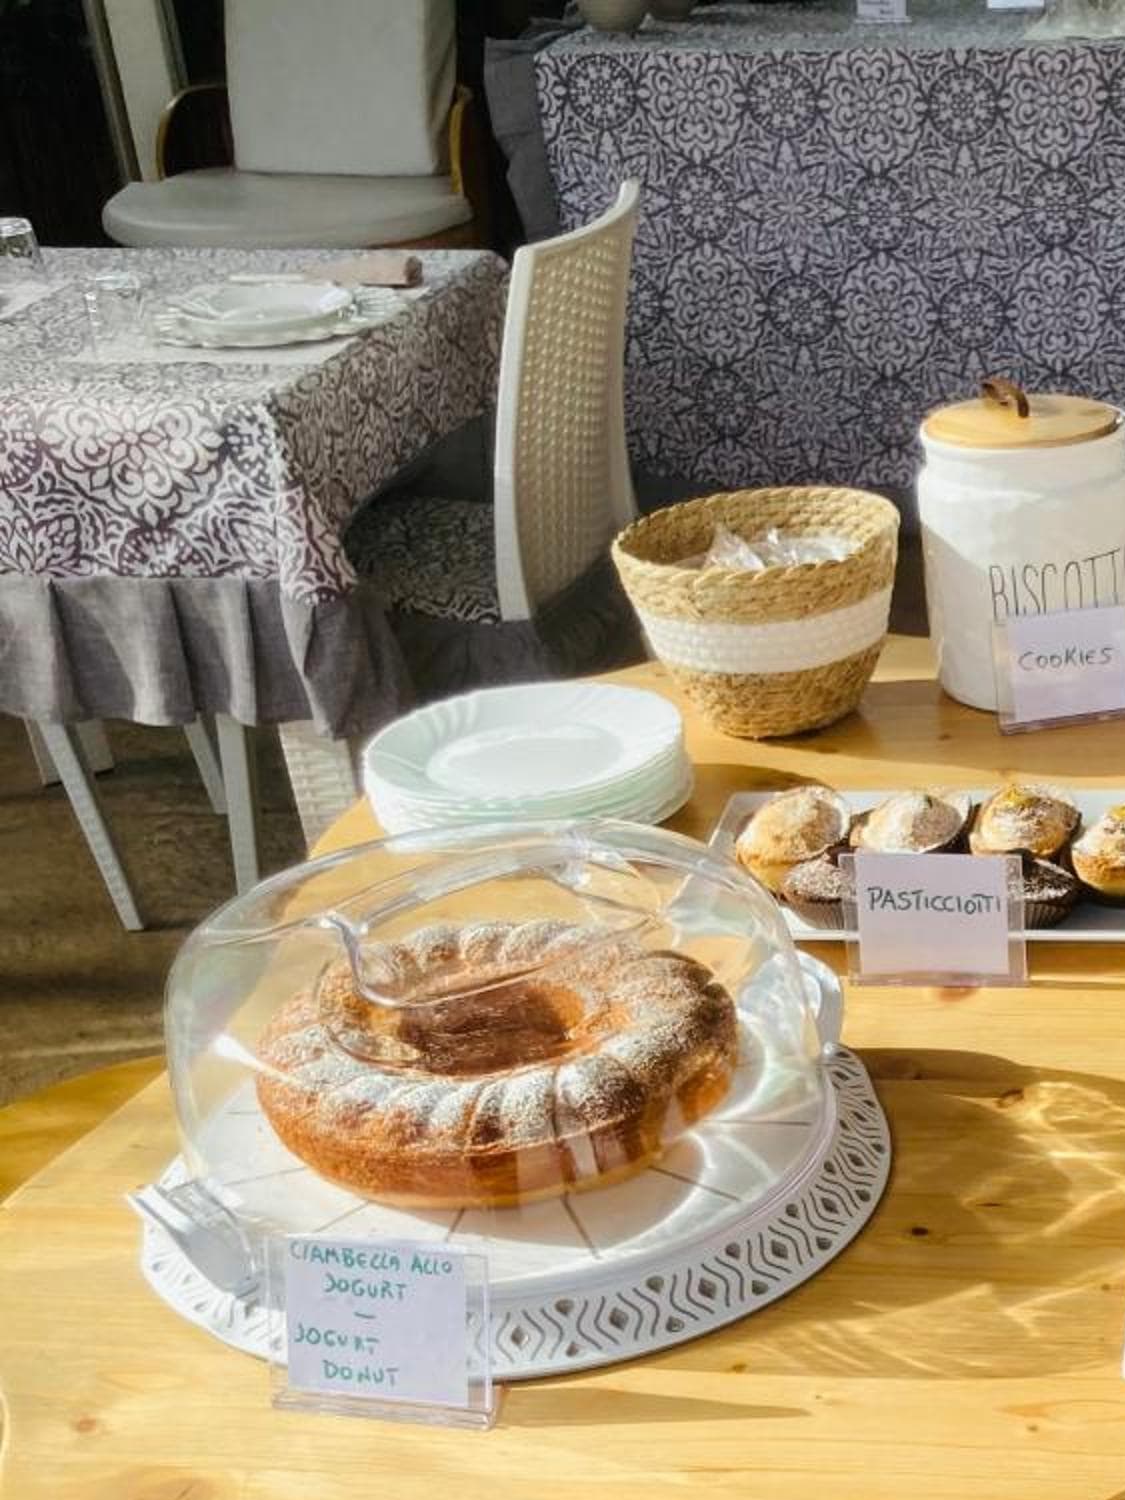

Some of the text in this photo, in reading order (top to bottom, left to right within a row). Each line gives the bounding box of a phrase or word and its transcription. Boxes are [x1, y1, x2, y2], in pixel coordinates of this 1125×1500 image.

[1018, 645, 1114, 672] COOKIES
[867, 886, 1001, 915] PASTICCIOTTI
[290, 1240, 453, 1275] CIAMBELLA ALLO
[322, 1359, 400, 1387] DONUT
